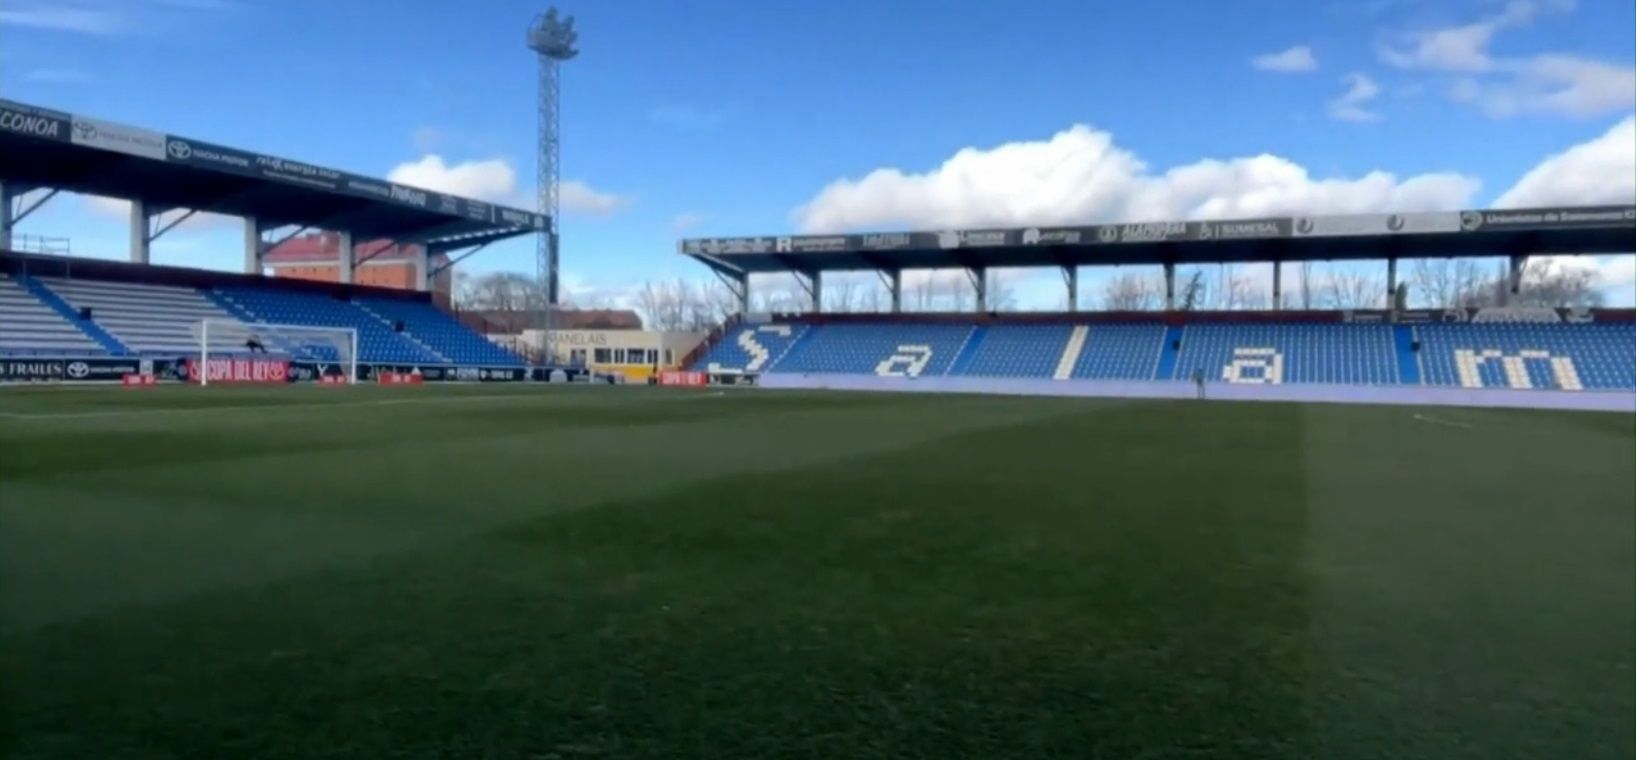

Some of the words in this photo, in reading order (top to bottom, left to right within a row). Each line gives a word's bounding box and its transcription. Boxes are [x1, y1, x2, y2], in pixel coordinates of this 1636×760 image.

[0, 109, 58, 138] CONOA
[9, 361, 62, 376] FRAILES
[207, 359, 233, 381] COPA
[234, 360, 251, 381] DEL
[252, 360, 269, 381] REY
